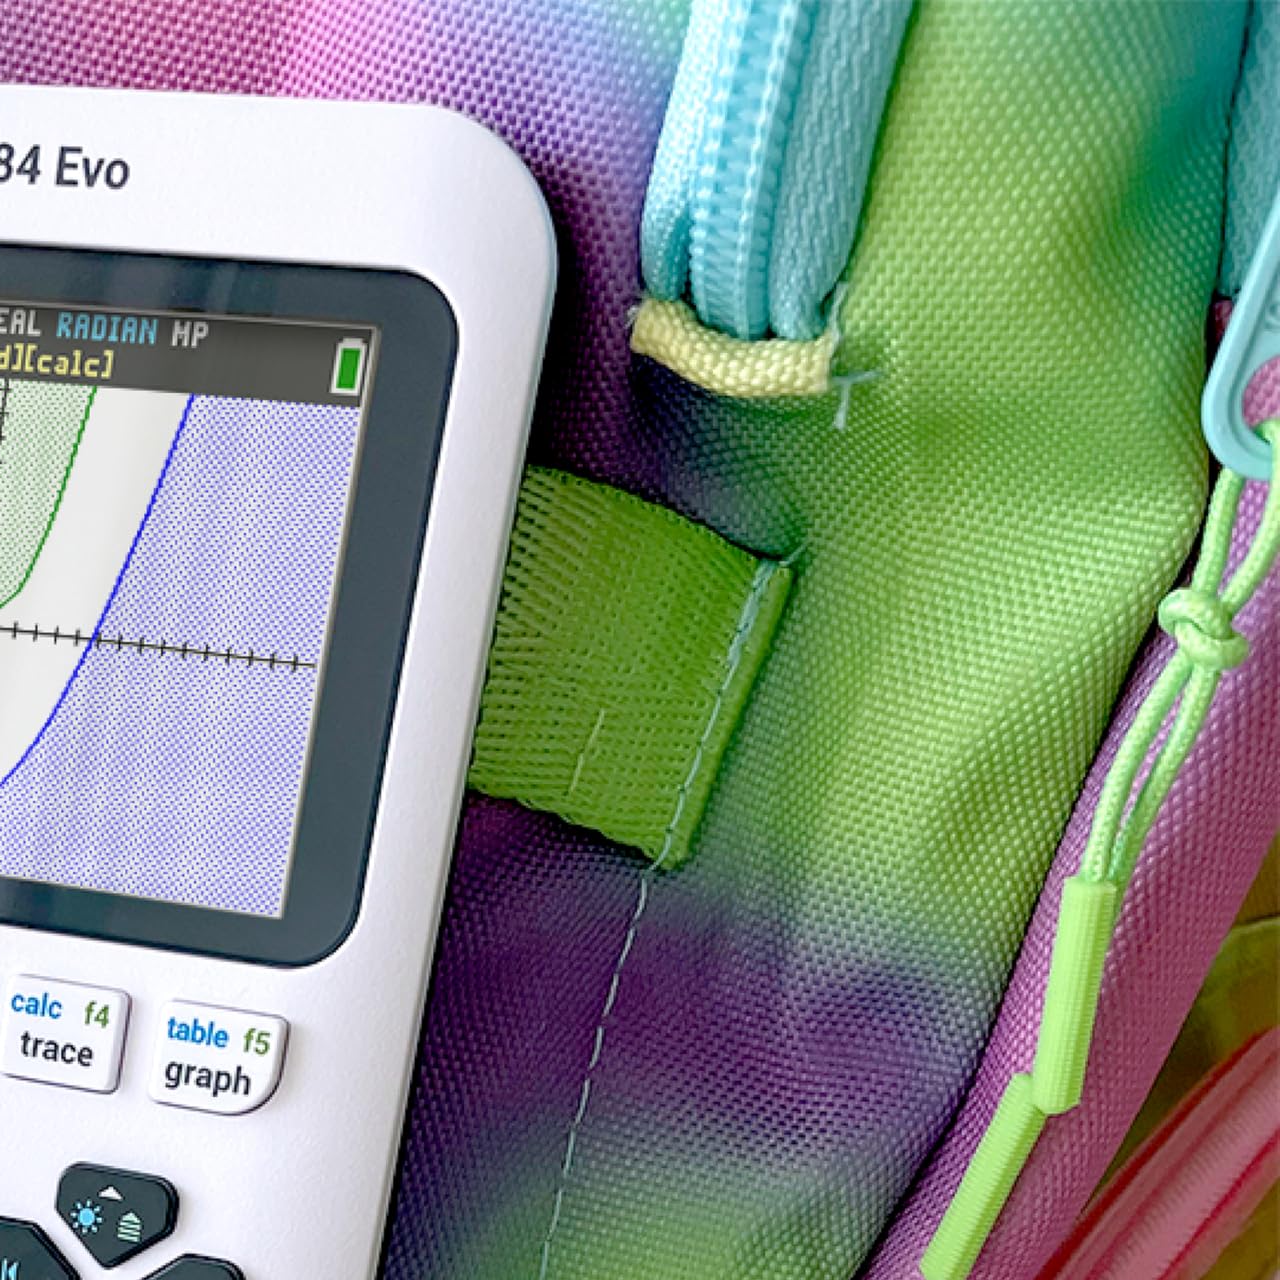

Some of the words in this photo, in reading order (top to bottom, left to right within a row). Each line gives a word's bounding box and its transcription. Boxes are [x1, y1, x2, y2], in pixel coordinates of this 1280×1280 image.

[55, 146, 130, 190] Evo
[56, 313, 157, 345] RADIAN
[171, 322, 209, 347] MP
[10, 991, 63, 1020] calc
[84, 1000, 110, 1029] f4
[20, 1031, 93, 1067] trace
[167, 1016, 230, 1049] table
[243, 1027, 271, 1056] f5
[165, 1061, 251, 1098] graph
